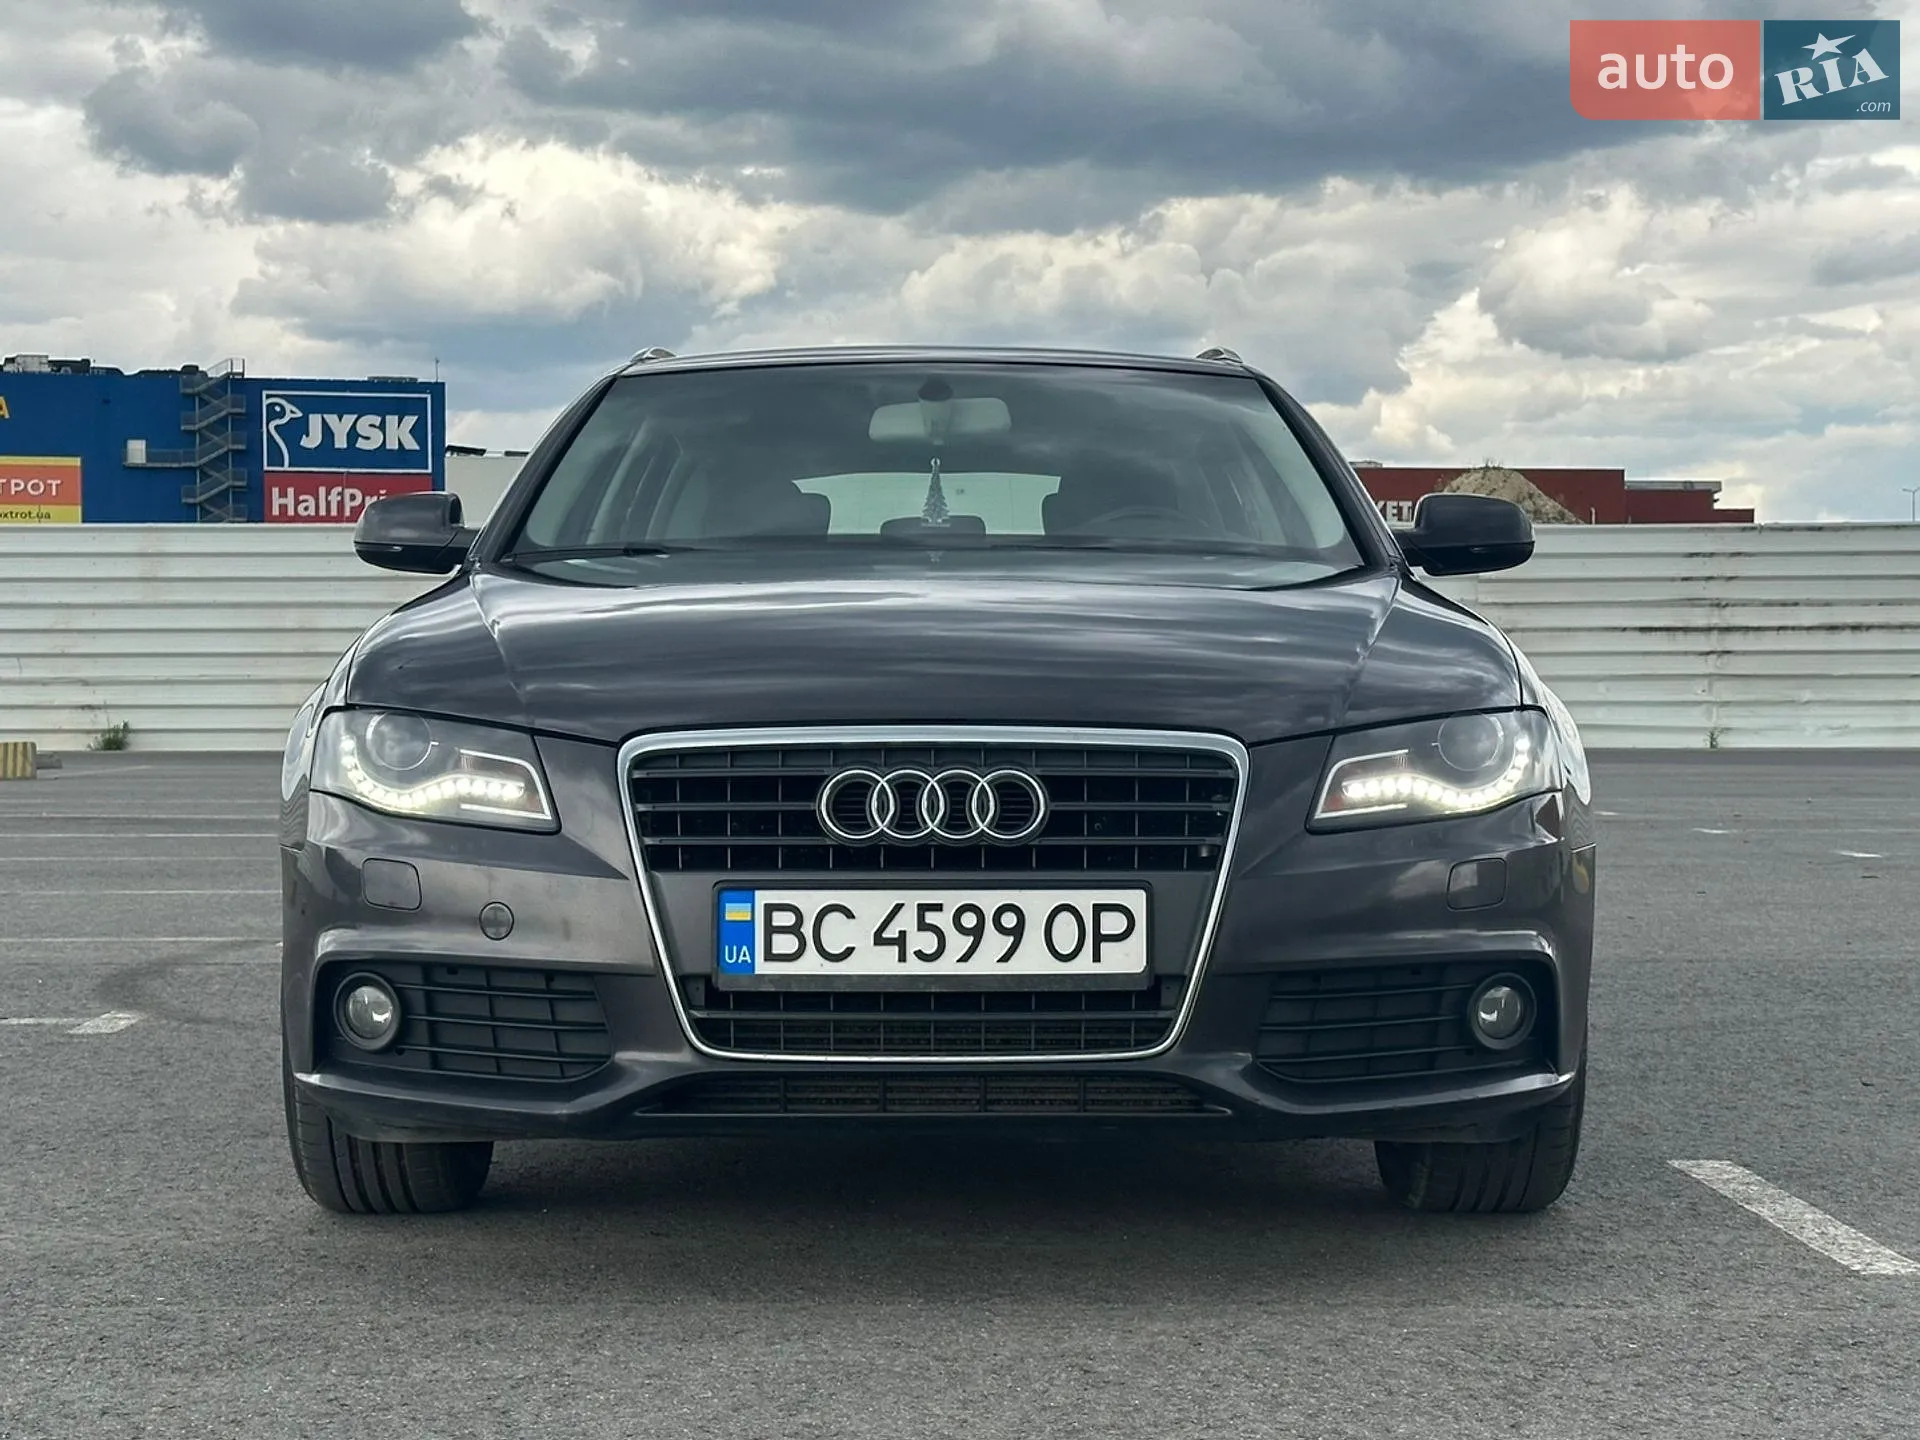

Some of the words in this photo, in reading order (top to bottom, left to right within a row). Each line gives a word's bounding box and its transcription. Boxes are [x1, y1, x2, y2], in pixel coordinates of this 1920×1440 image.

[299, 413, 421, 451] JYSK
[0, 510, 52, 520] xtrot.ua
[271, 486, 387, 517] HalfP
[762, 902, 857, 963] BC
[872, 902, 1027, 963] 4599
[1042, 902, 1137, 963] OP
[724, 945, 752, 964] UA
